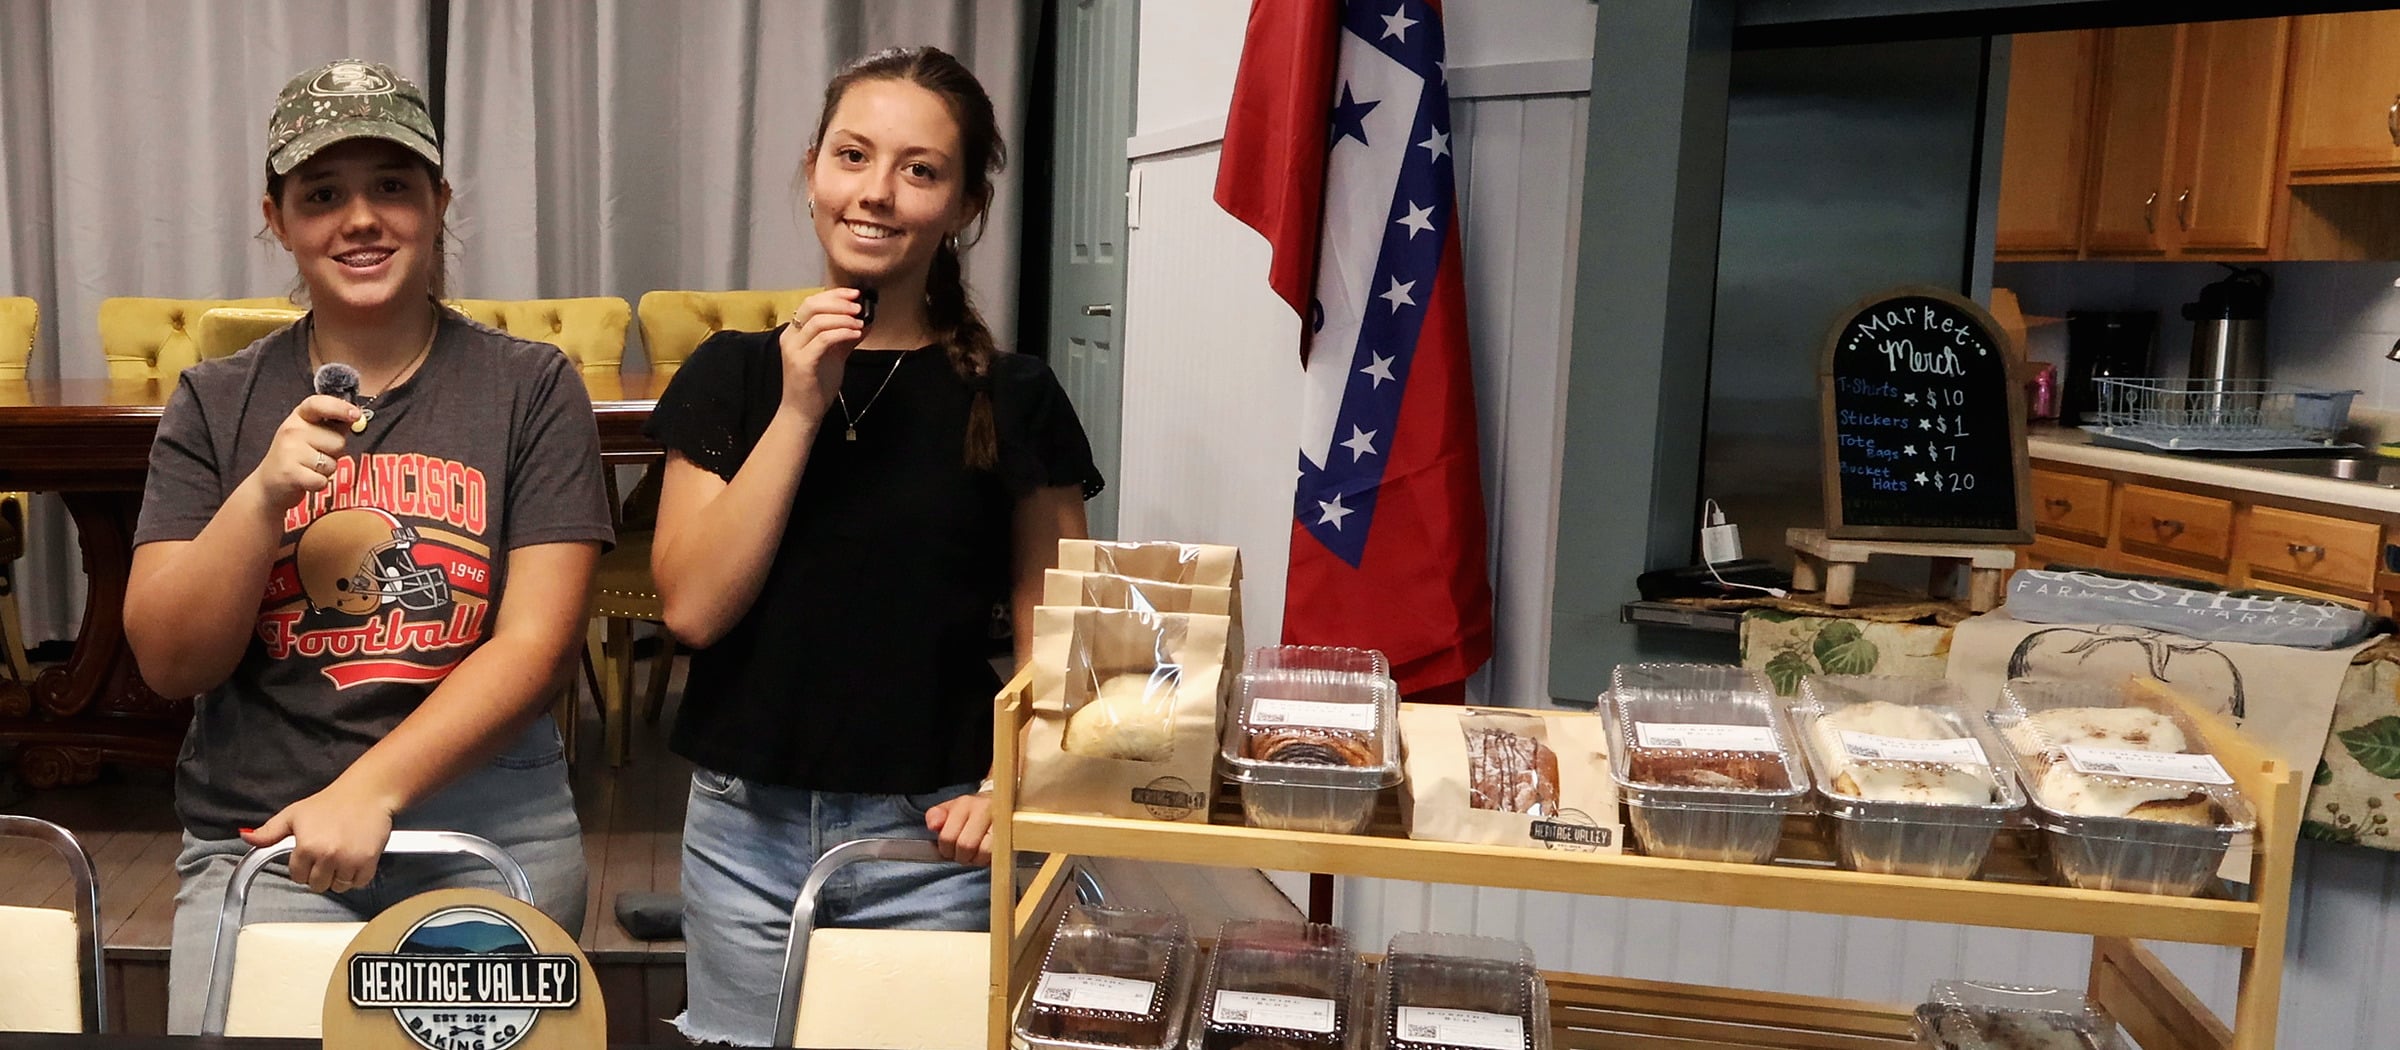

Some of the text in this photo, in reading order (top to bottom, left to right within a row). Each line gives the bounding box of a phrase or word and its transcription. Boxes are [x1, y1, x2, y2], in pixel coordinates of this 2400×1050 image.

[1858, 305, 1970, 346] Market
[1878, 339, 1966, 377] Merch
[1838, 376, 1899, 398] T-Shirts
[1840, 409, 1909, 429] Stickers
[1838, 433, 1875, 448] Tote
[1866, 449, 1899, 462] Bags
[1840, 461, 1891, 477] Bucket
[1872, 478, 1908, 491] Hats
[451, 561, 486, 582] 1946
[2187, 608, 2326, 628] MARKET
[257, 602, 488, 660] Football
[1534, 823, 1608, 844] HERITAGE VALLEY
[361, 962, 567, 1001] HERITAGE VALLEY
[433, 1014, 497, 1023] EST 2024
[409, 1016, 517, 1050] BAKING CO
